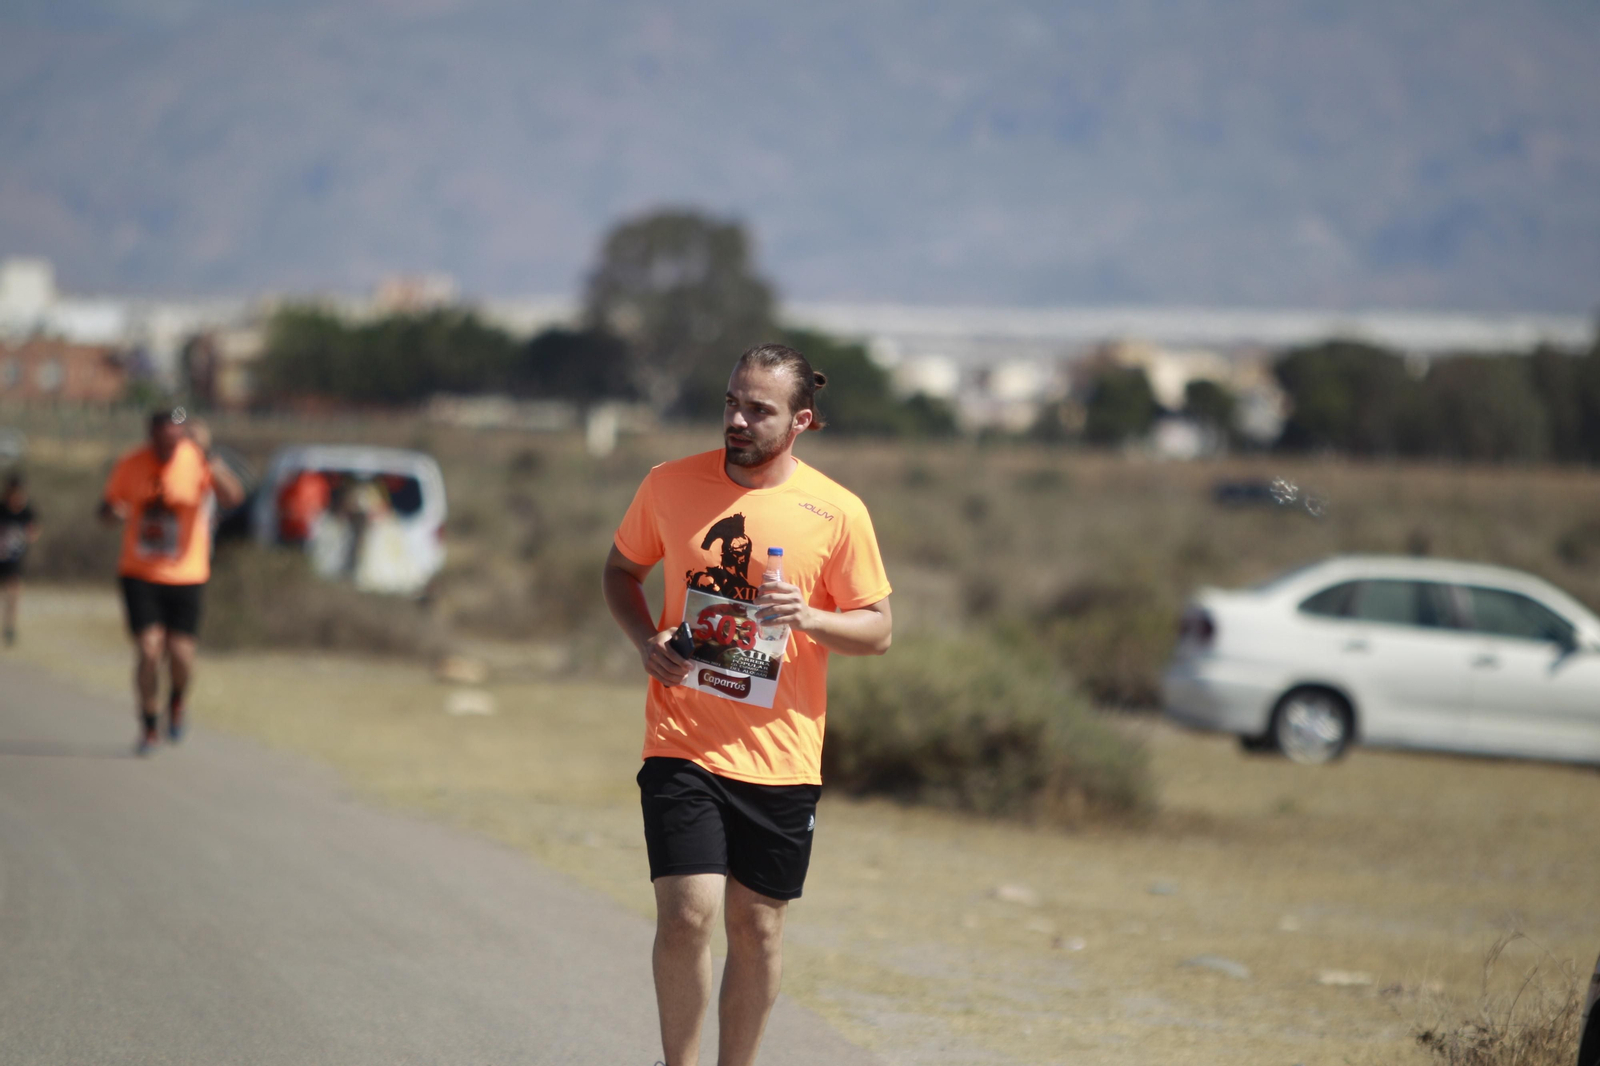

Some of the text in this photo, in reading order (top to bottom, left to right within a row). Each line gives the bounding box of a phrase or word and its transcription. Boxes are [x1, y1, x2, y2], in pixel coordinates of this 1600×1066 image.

[798, 502, 835, 521] JOLUVI
[695, 610, 758, 650] 503
[733, 655, 770, 667] CARRERA
[734, 646, 771, 662] XIII
[732, 659, 769, 671] POPULAR
